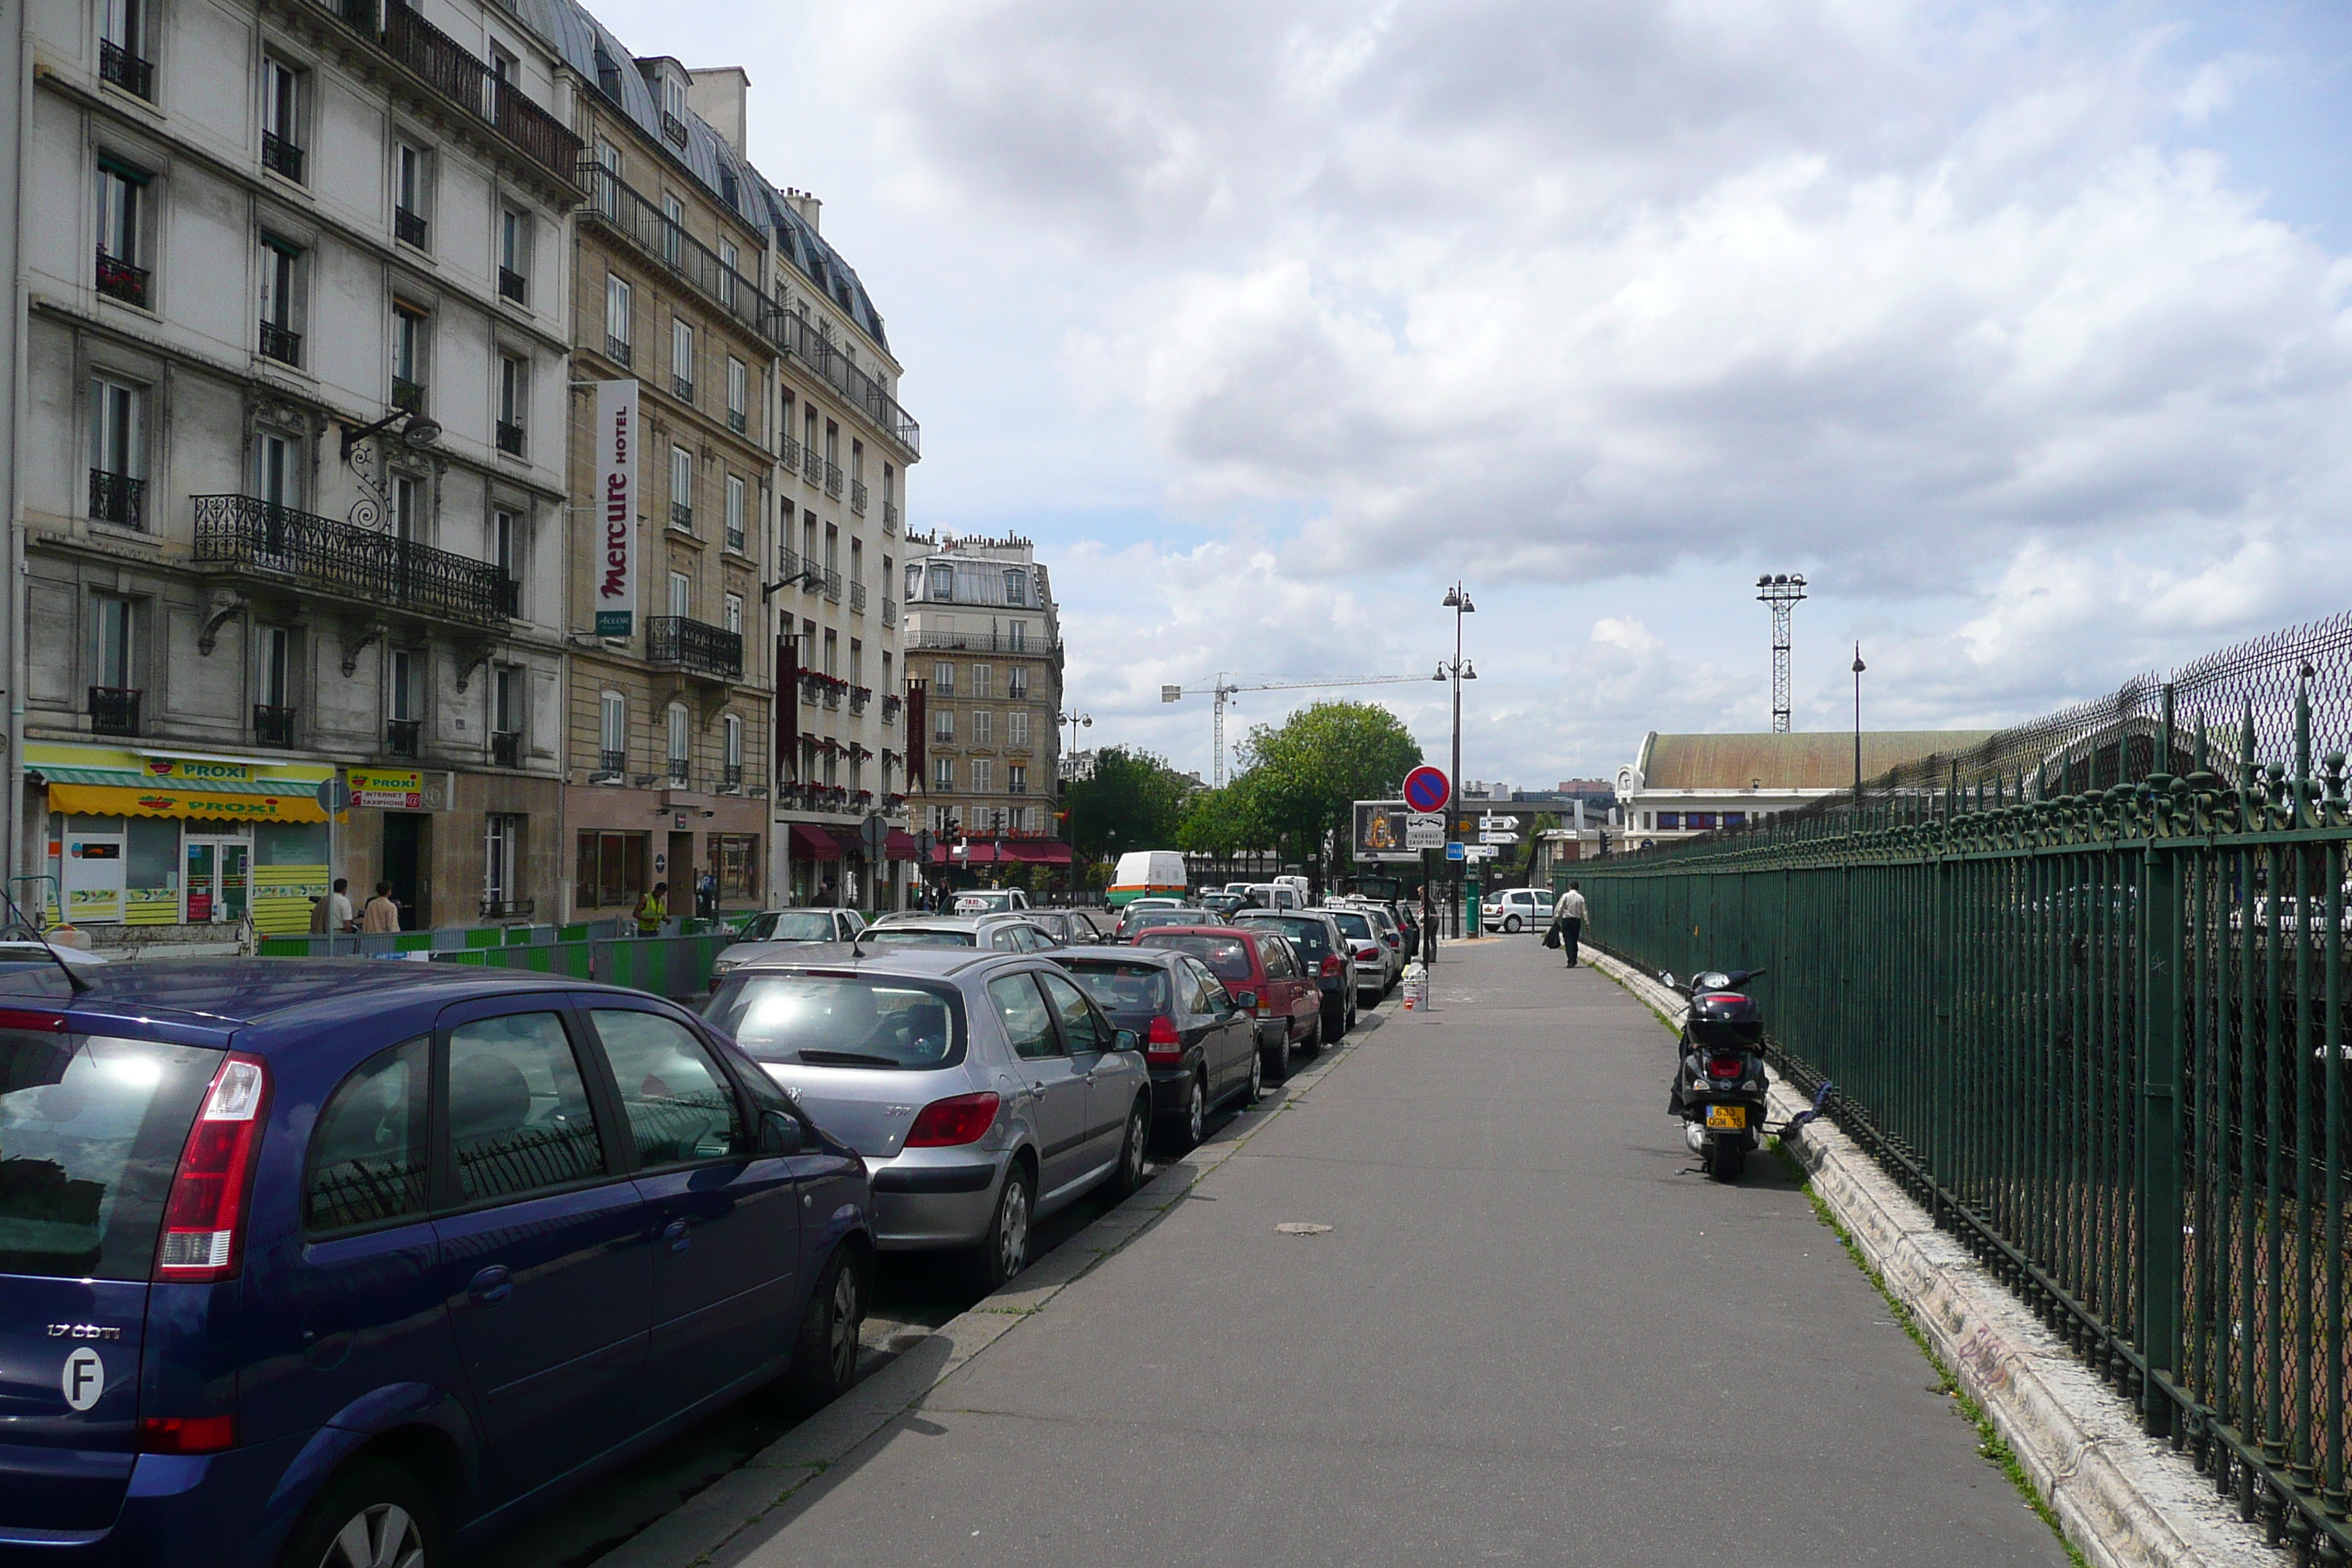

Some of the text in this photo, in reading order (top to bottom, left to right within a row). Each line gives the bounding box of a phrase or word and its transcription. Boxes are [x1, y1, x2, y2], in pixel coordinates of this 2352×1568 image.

[616, 406, 626, 463] HOTEL
[1731, 1117, 1743, 1126] 75
[72, 1359, 96, 1401] F
